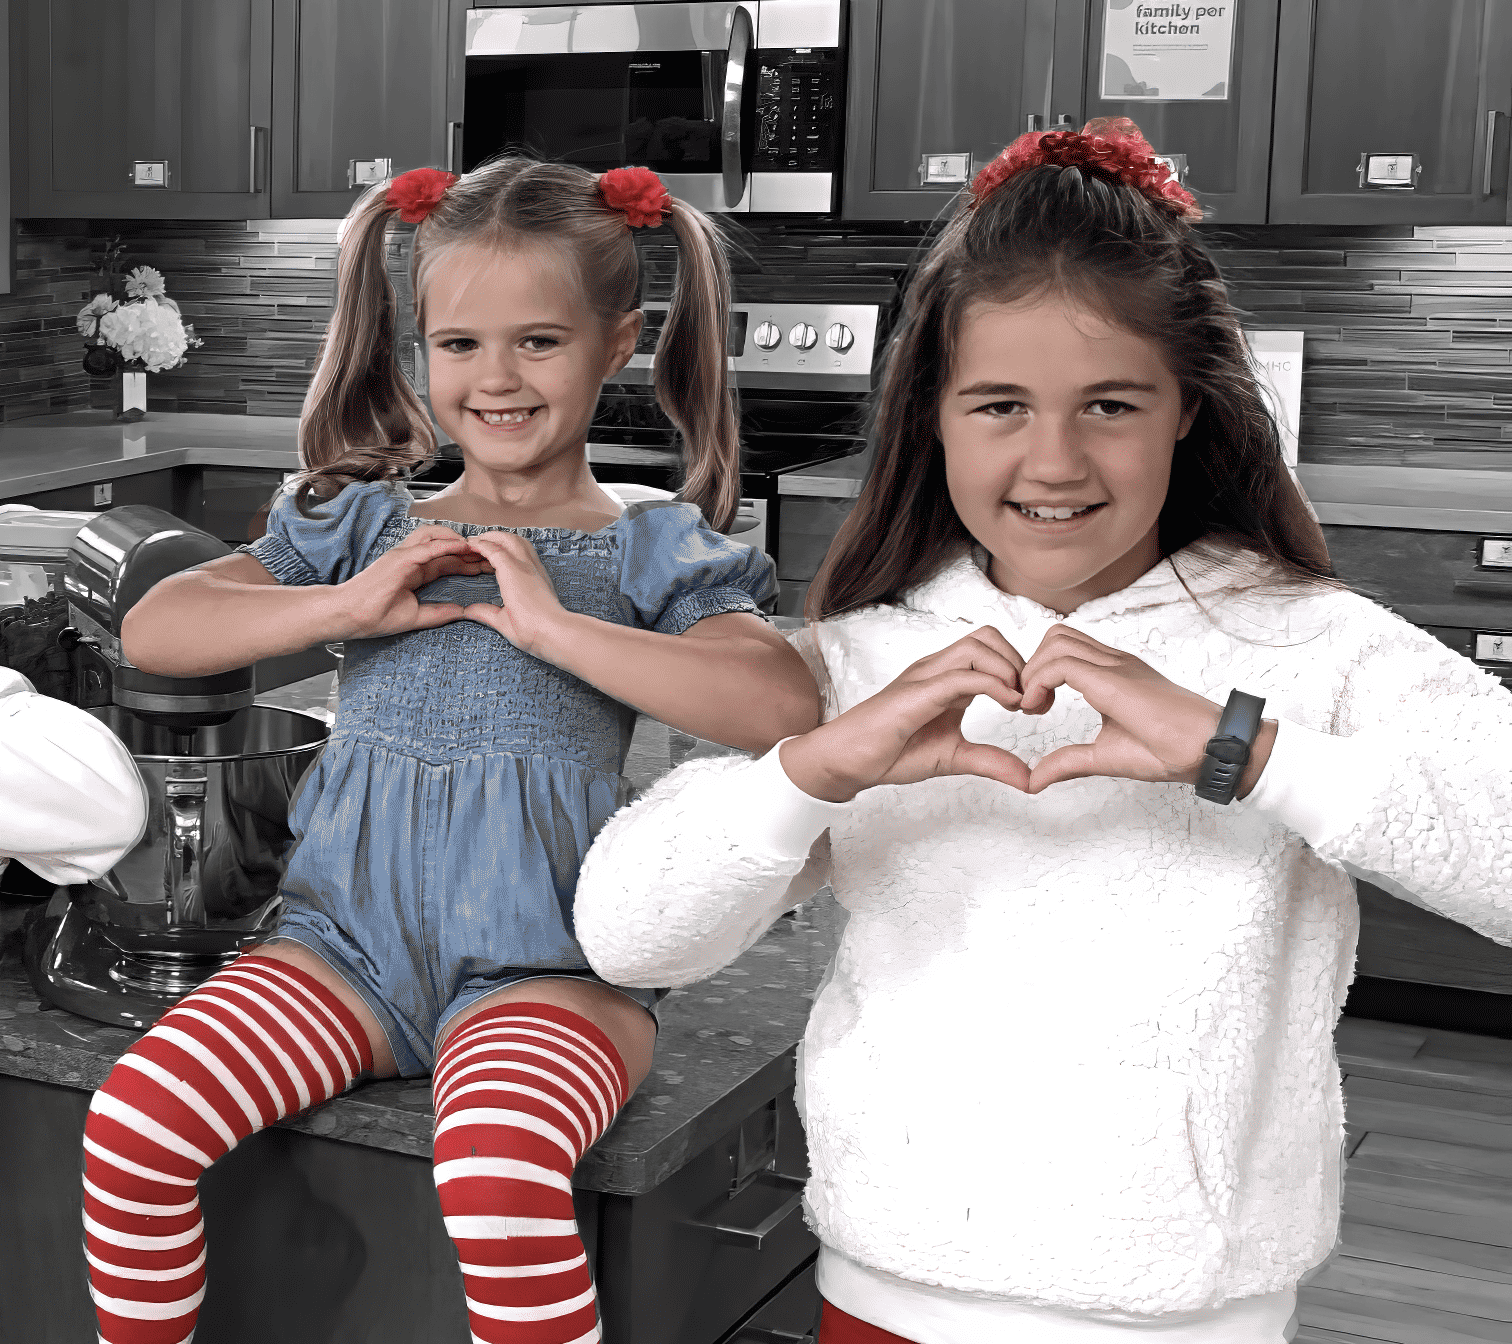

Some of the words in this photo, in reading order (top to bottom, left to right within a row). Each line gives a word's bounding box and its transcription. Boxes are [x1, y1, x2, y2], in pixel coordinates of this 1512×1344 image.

[1136, 4, 1191, 20] family
[1195, 7, 1225, 20] per
[1135, 21, 1200, 35] kitchen
